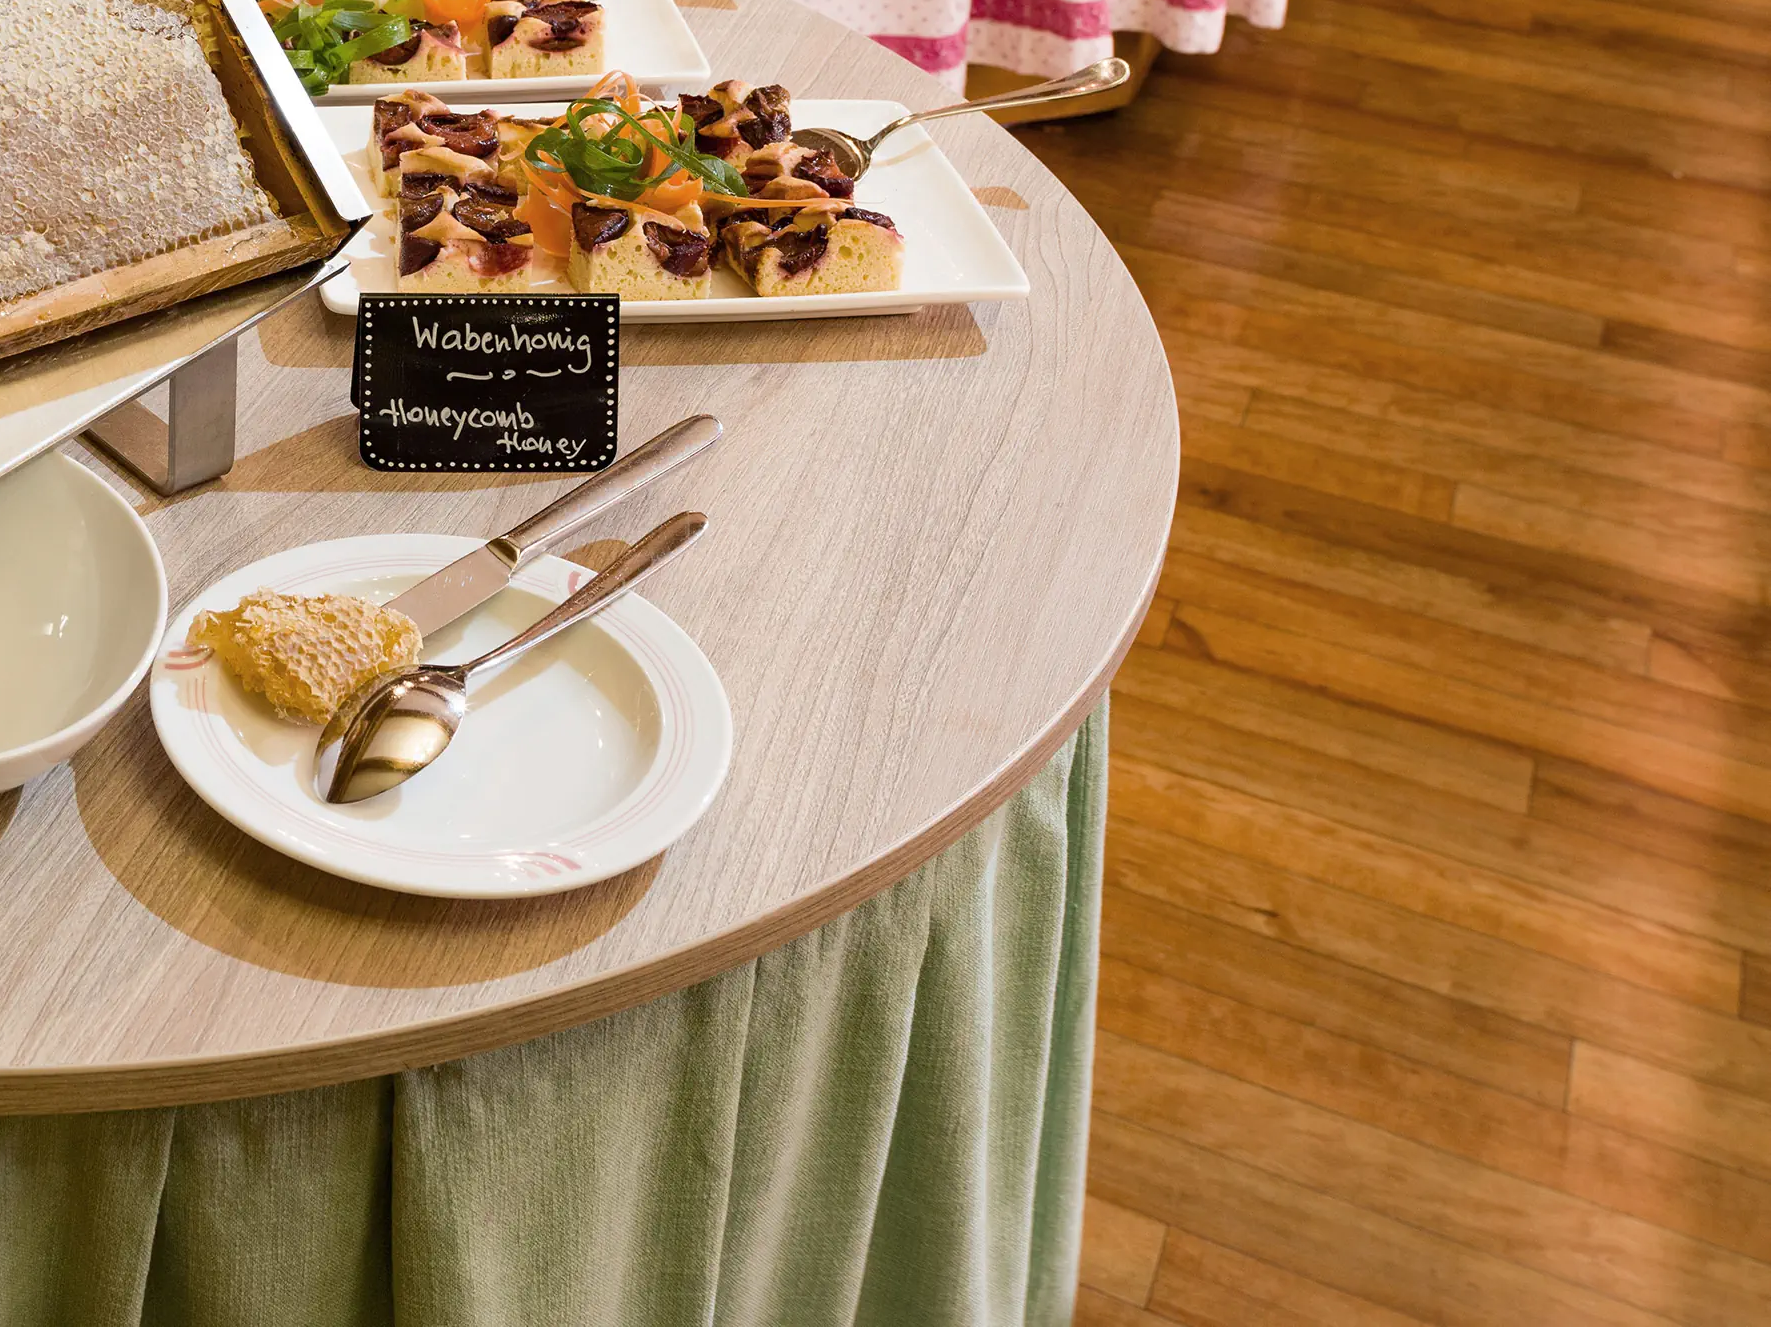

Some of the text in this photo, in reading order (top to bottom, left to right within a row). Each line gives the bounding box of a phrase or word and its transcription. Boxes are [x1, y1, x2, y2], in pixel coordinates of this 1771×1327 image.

[412, 315, 592, 374] Wabenhonig
[379, 398, 535, 440] Honeycomb
[496, 430, 587, 459] Honey
